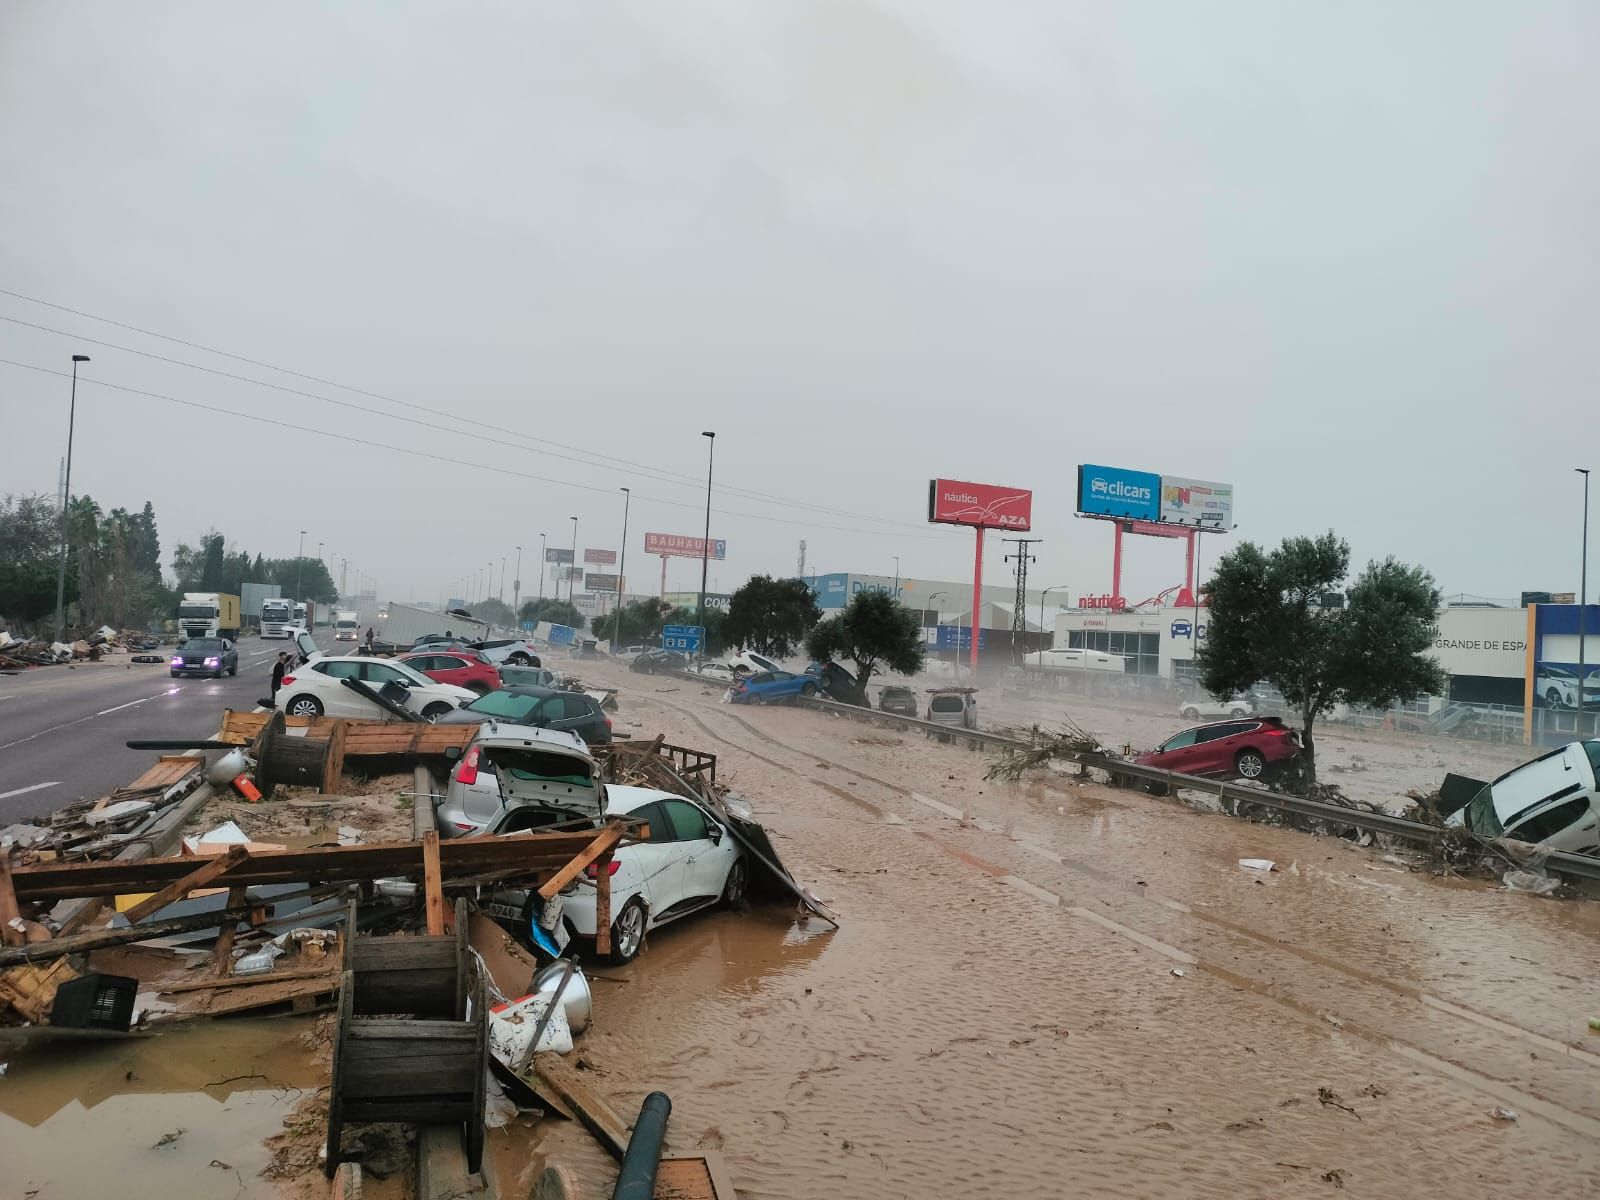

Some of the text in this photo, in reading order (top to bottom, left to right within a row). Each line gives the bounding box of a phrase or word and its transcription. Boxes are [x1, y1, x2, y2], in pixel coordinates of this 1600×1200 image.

[1108, 480, 1151, 500] clicars
[943, 491, 978, 504] náutica
[998, 514, 1027, 526] AZA
[1078, 593, 1126, 609] náutia
[1435, 639, 1481, 649] GRANDE
[1484, 640, 1499, 650] DE
